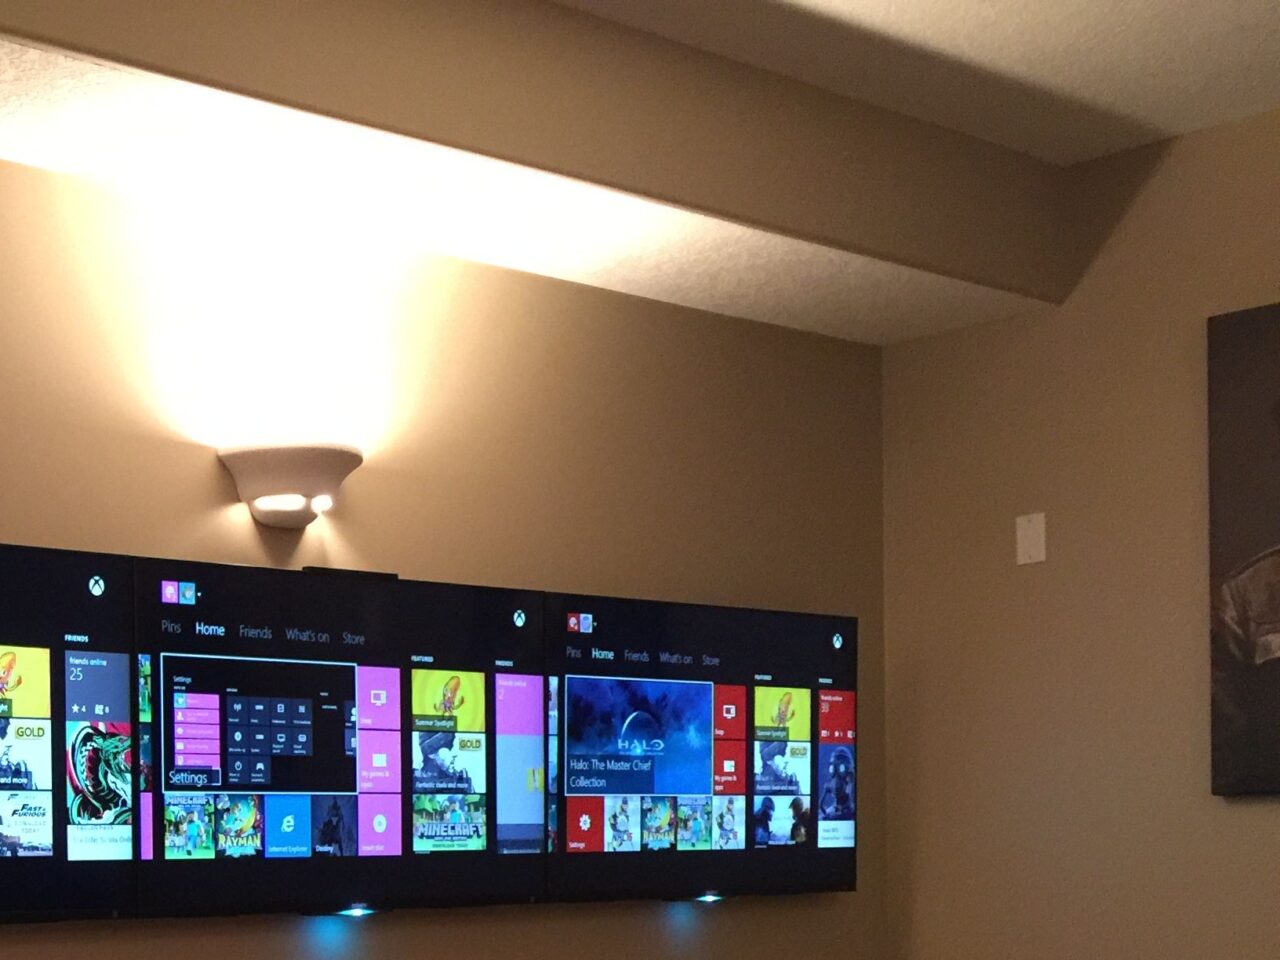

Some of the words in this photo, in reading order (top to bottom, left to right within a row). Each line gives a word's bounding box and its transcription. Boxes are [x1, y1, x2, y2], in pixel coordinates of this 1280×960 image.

[64, 634, 89, 642] FRIENDS
[161, 620, 181, 633] Pins
[196, 622, 225, 636] Home
[239, 625, 272, 639] Friends
[285, 628, 315, 642] What's
[317, 633, 330, 643] on
[342, 632, 365, 645] Store
[69, 656, 89, 665] friends
[566, 646, 581, 658] Pins
[592, 648, 615, 660] Home
[624, 650, 650, 662] Friends
[659, 652, 682, 664] What's
[683, 655, 693, 664] on
[702, 654, 720, 666] Store
[69, 668, 83, 680] 25
[17, 727, 45, 738] GOLD
[460, 739, 481, 748] GOLD
[618, 739, 664, 750] HALO
[570, 759, 589, 770] Halo:
[591, 759, 605, 770] The
[607, 760, 630, 770] Master
[632, 760, 651, 771] Chief
[0, 776, 12, 784] and
[169, 770, 208, 787] Settings
[570, 776, 606, 787] Collection
[11, 809, 46, 817] FURIOUS
[417, 822, 483, 838] MINECRAFT
[219, 833, 261, 848] RAYMAN
